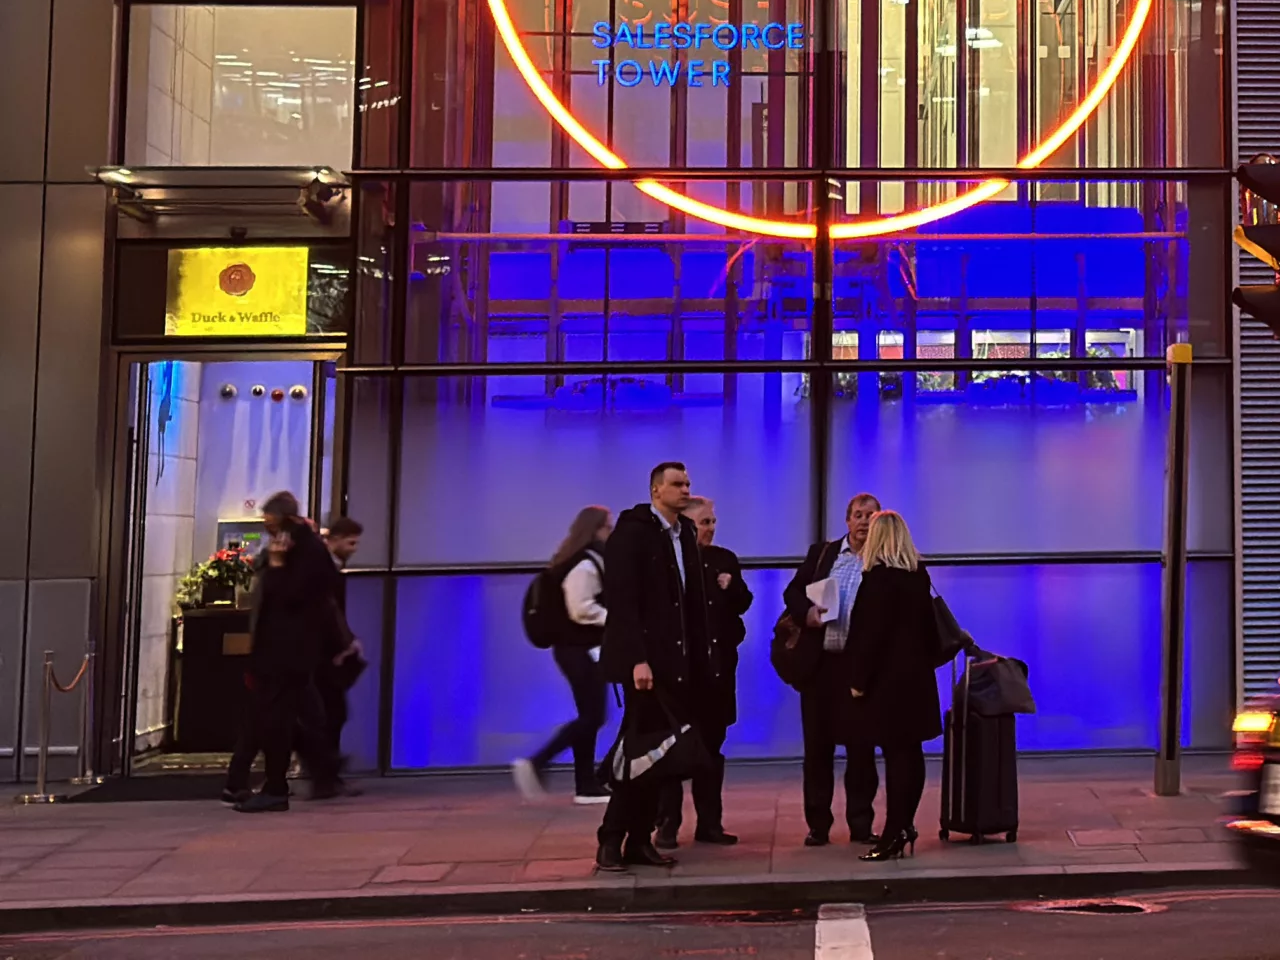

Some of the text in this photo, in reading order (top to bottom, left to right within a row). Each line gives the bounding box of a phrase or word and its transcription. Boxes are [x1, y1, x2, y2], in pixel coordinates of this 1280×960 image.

[592, 22, 804, 50] SALESFORCE
[592, 59, 731, 87] TOWER
[191, 311, 227, 323] Duck
[237, 311, 281, 323] Waffle
